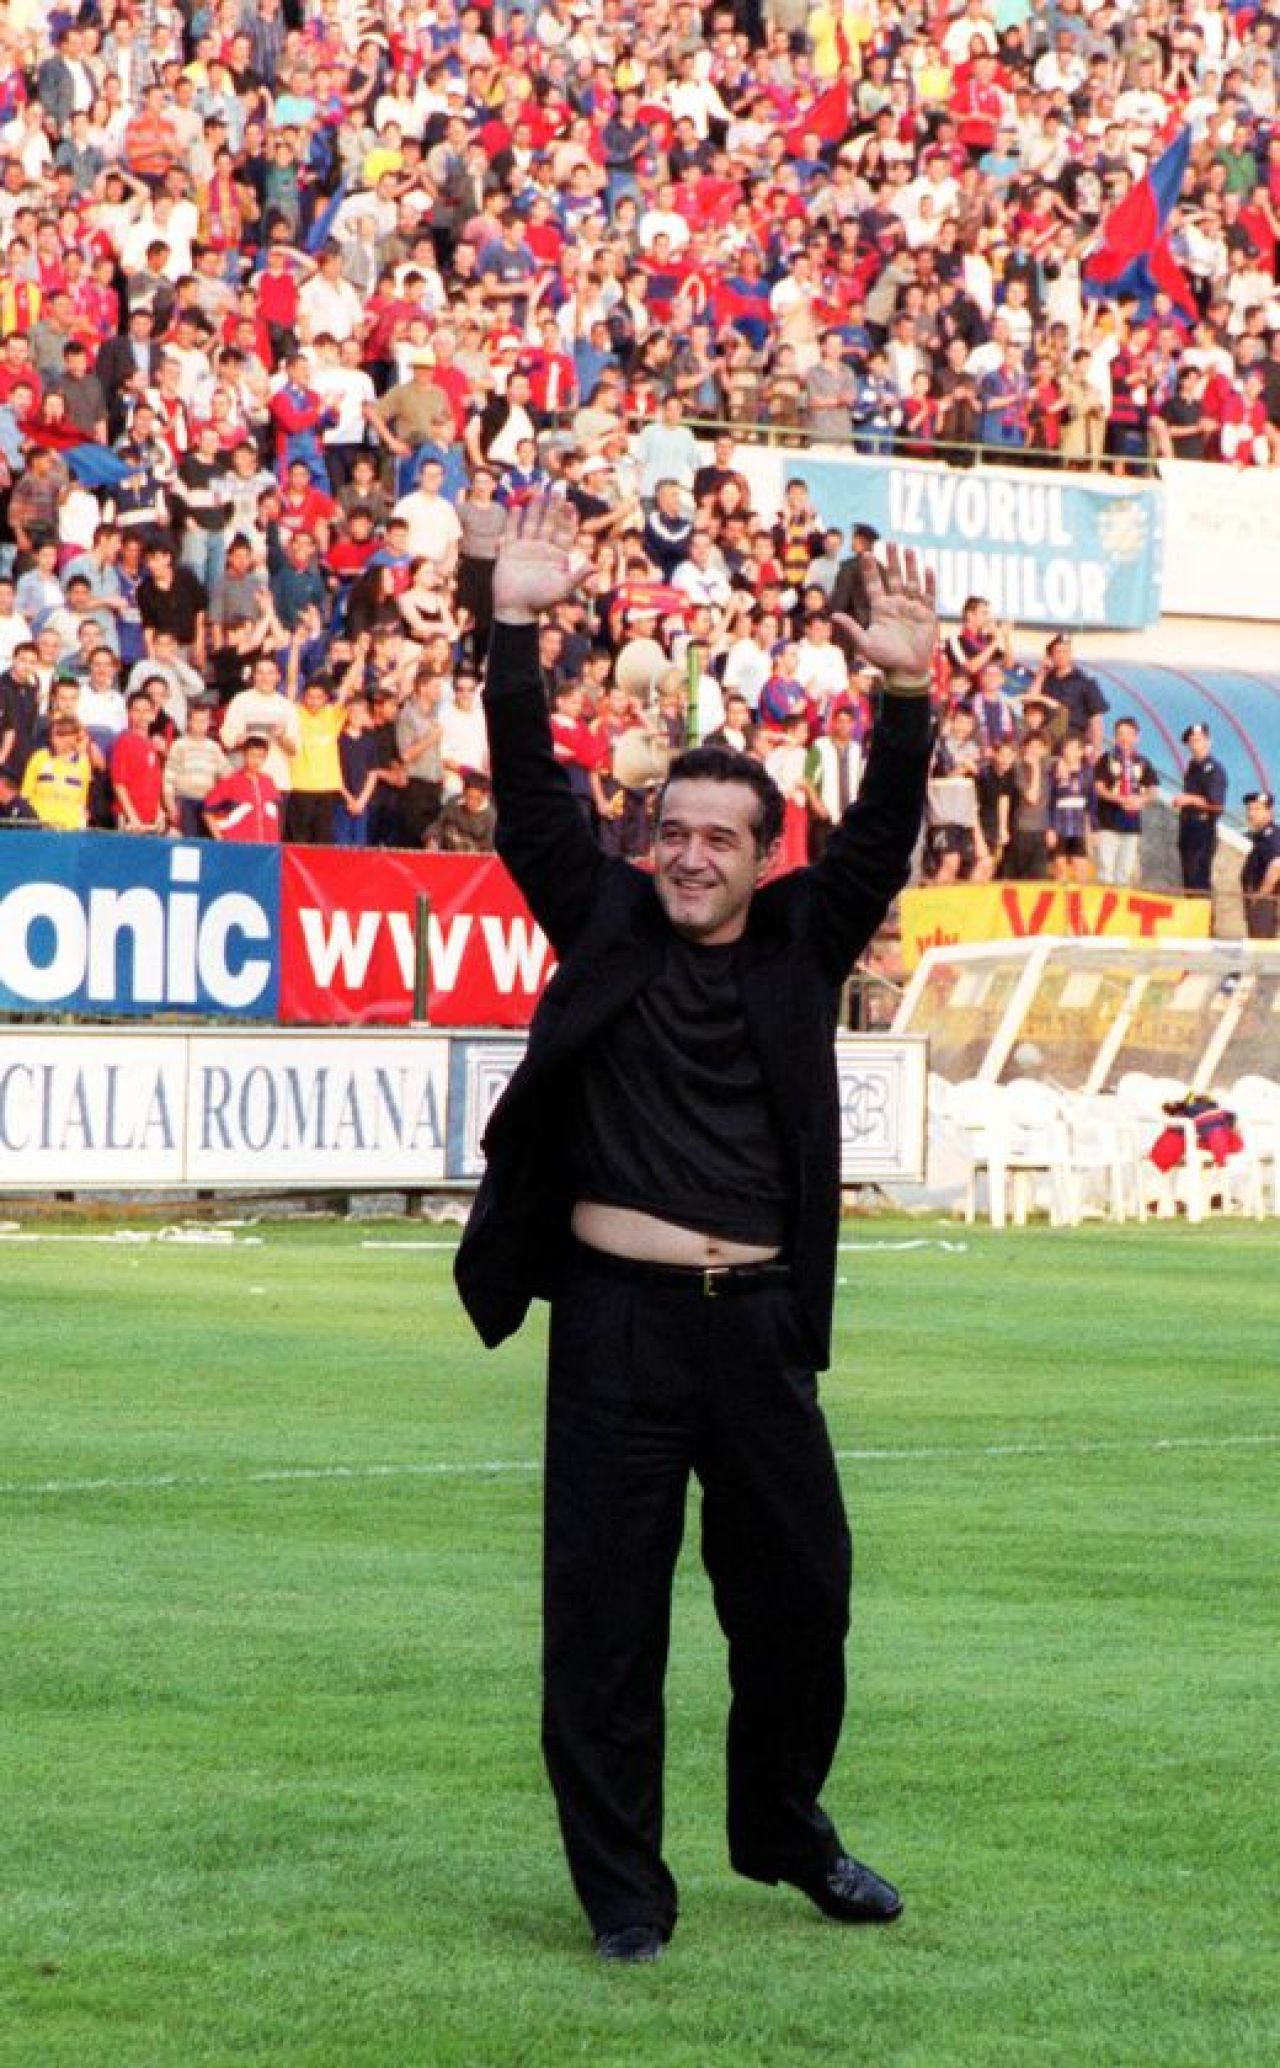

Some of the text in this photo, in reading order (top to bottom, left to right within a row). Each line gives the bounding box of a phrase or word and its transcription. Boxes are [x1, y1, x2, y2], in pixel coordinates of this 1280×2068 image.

[889, 470, 1072, 545] IZVORUL
[0, 846, 271, 1008] onic
[0, 1063, 446, 1151] CIALA ROMANA
